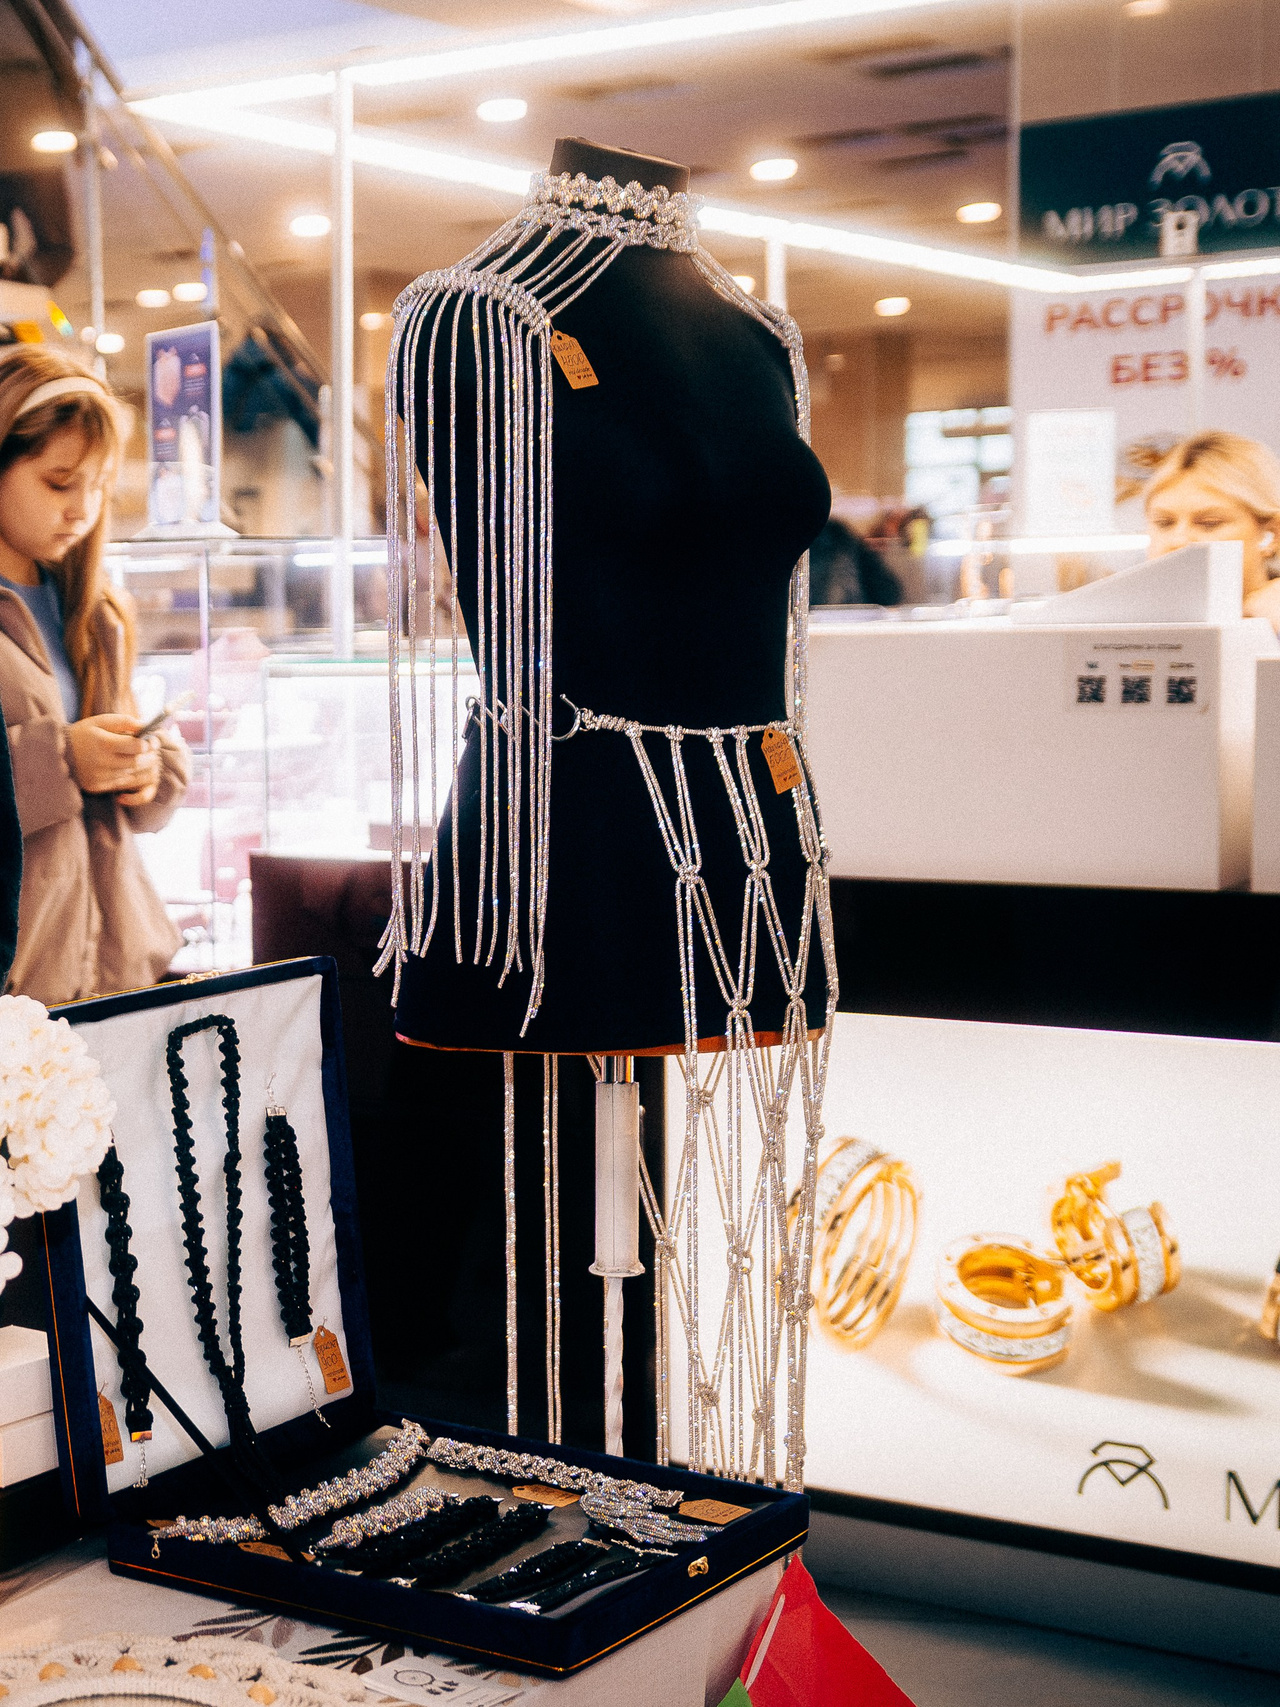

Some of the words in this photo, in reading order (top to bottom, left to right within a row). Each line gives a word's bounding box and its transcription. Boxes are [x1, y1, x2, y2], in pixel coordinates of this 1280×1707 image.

[1042, 202, 1138, 243] МИР
[1109, 350, 1190, 386] БЕЗ
[1206, 348, 1247, 379] %
[321, 1353, 338, 1370] 900
